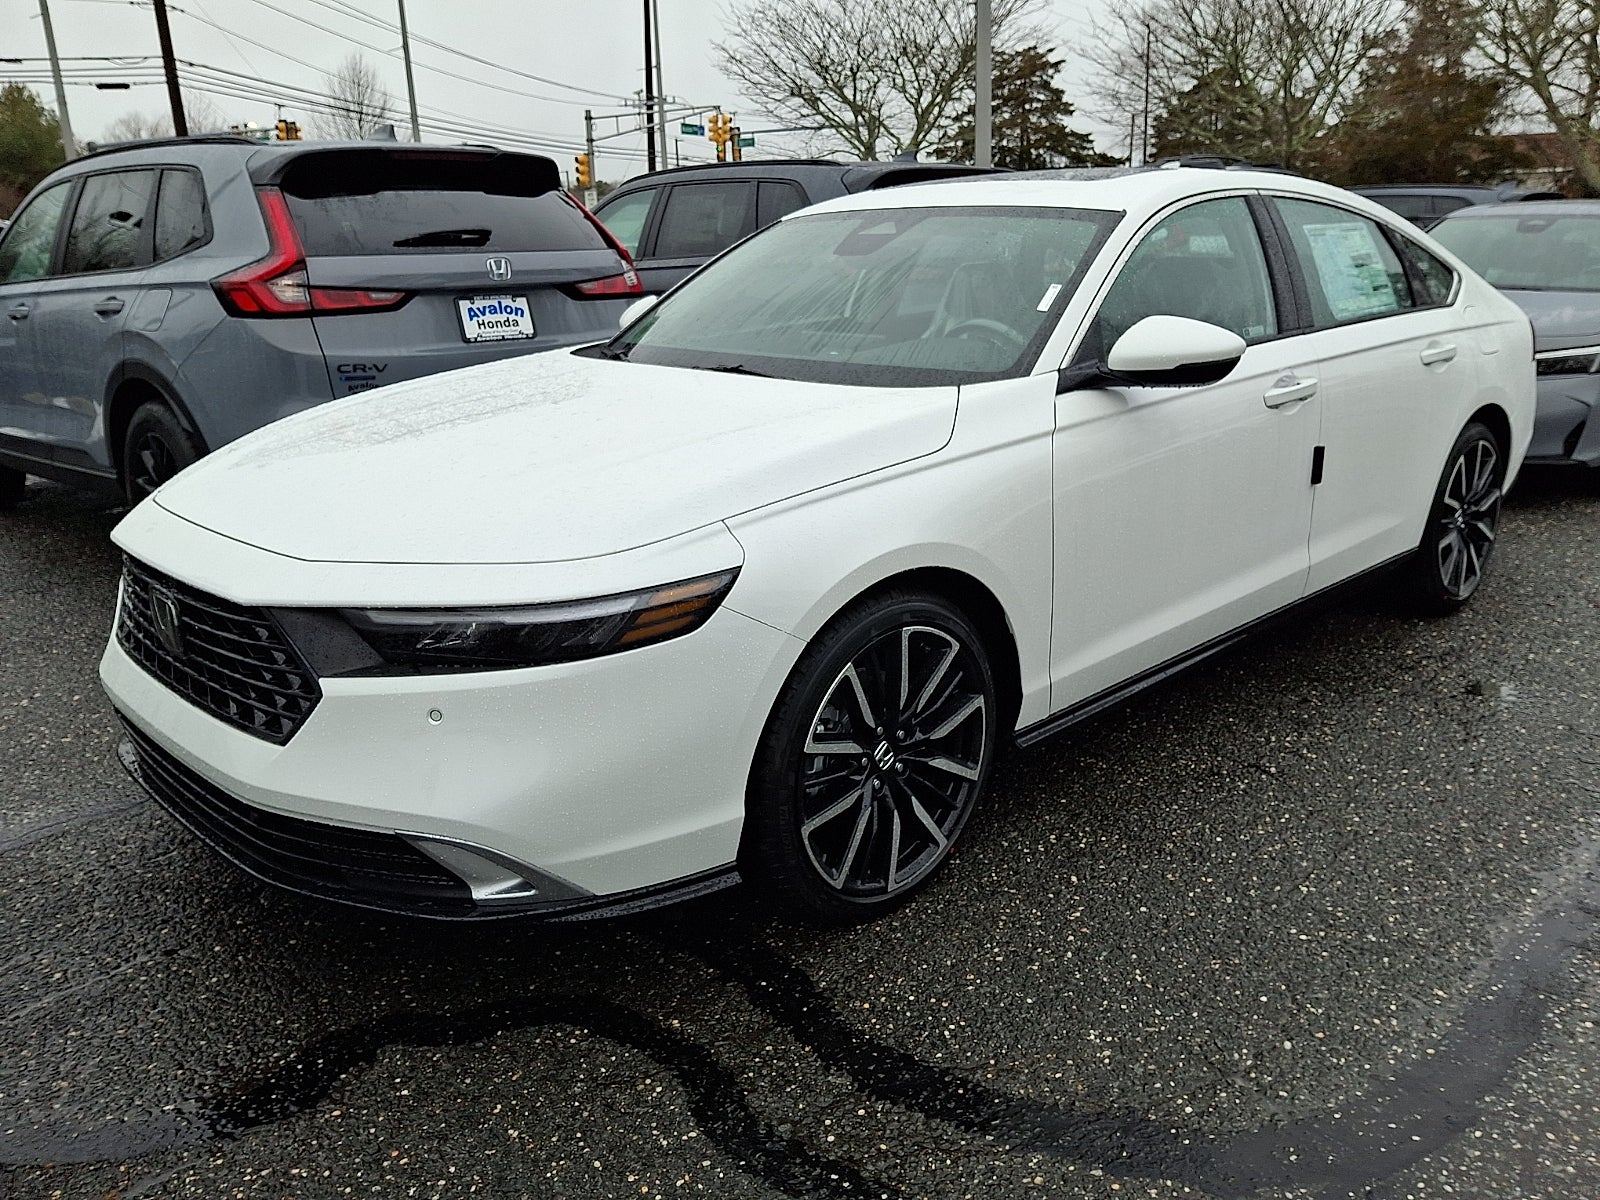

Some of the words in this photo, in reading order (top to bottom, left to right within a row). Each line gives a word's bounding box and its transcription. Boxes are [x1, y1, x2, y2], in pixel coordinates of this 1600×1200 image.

[467, 301, 525, 321] Avalon
[477, 317, 520, 329] Honda
[337, 363, 388, 373] CR-V
